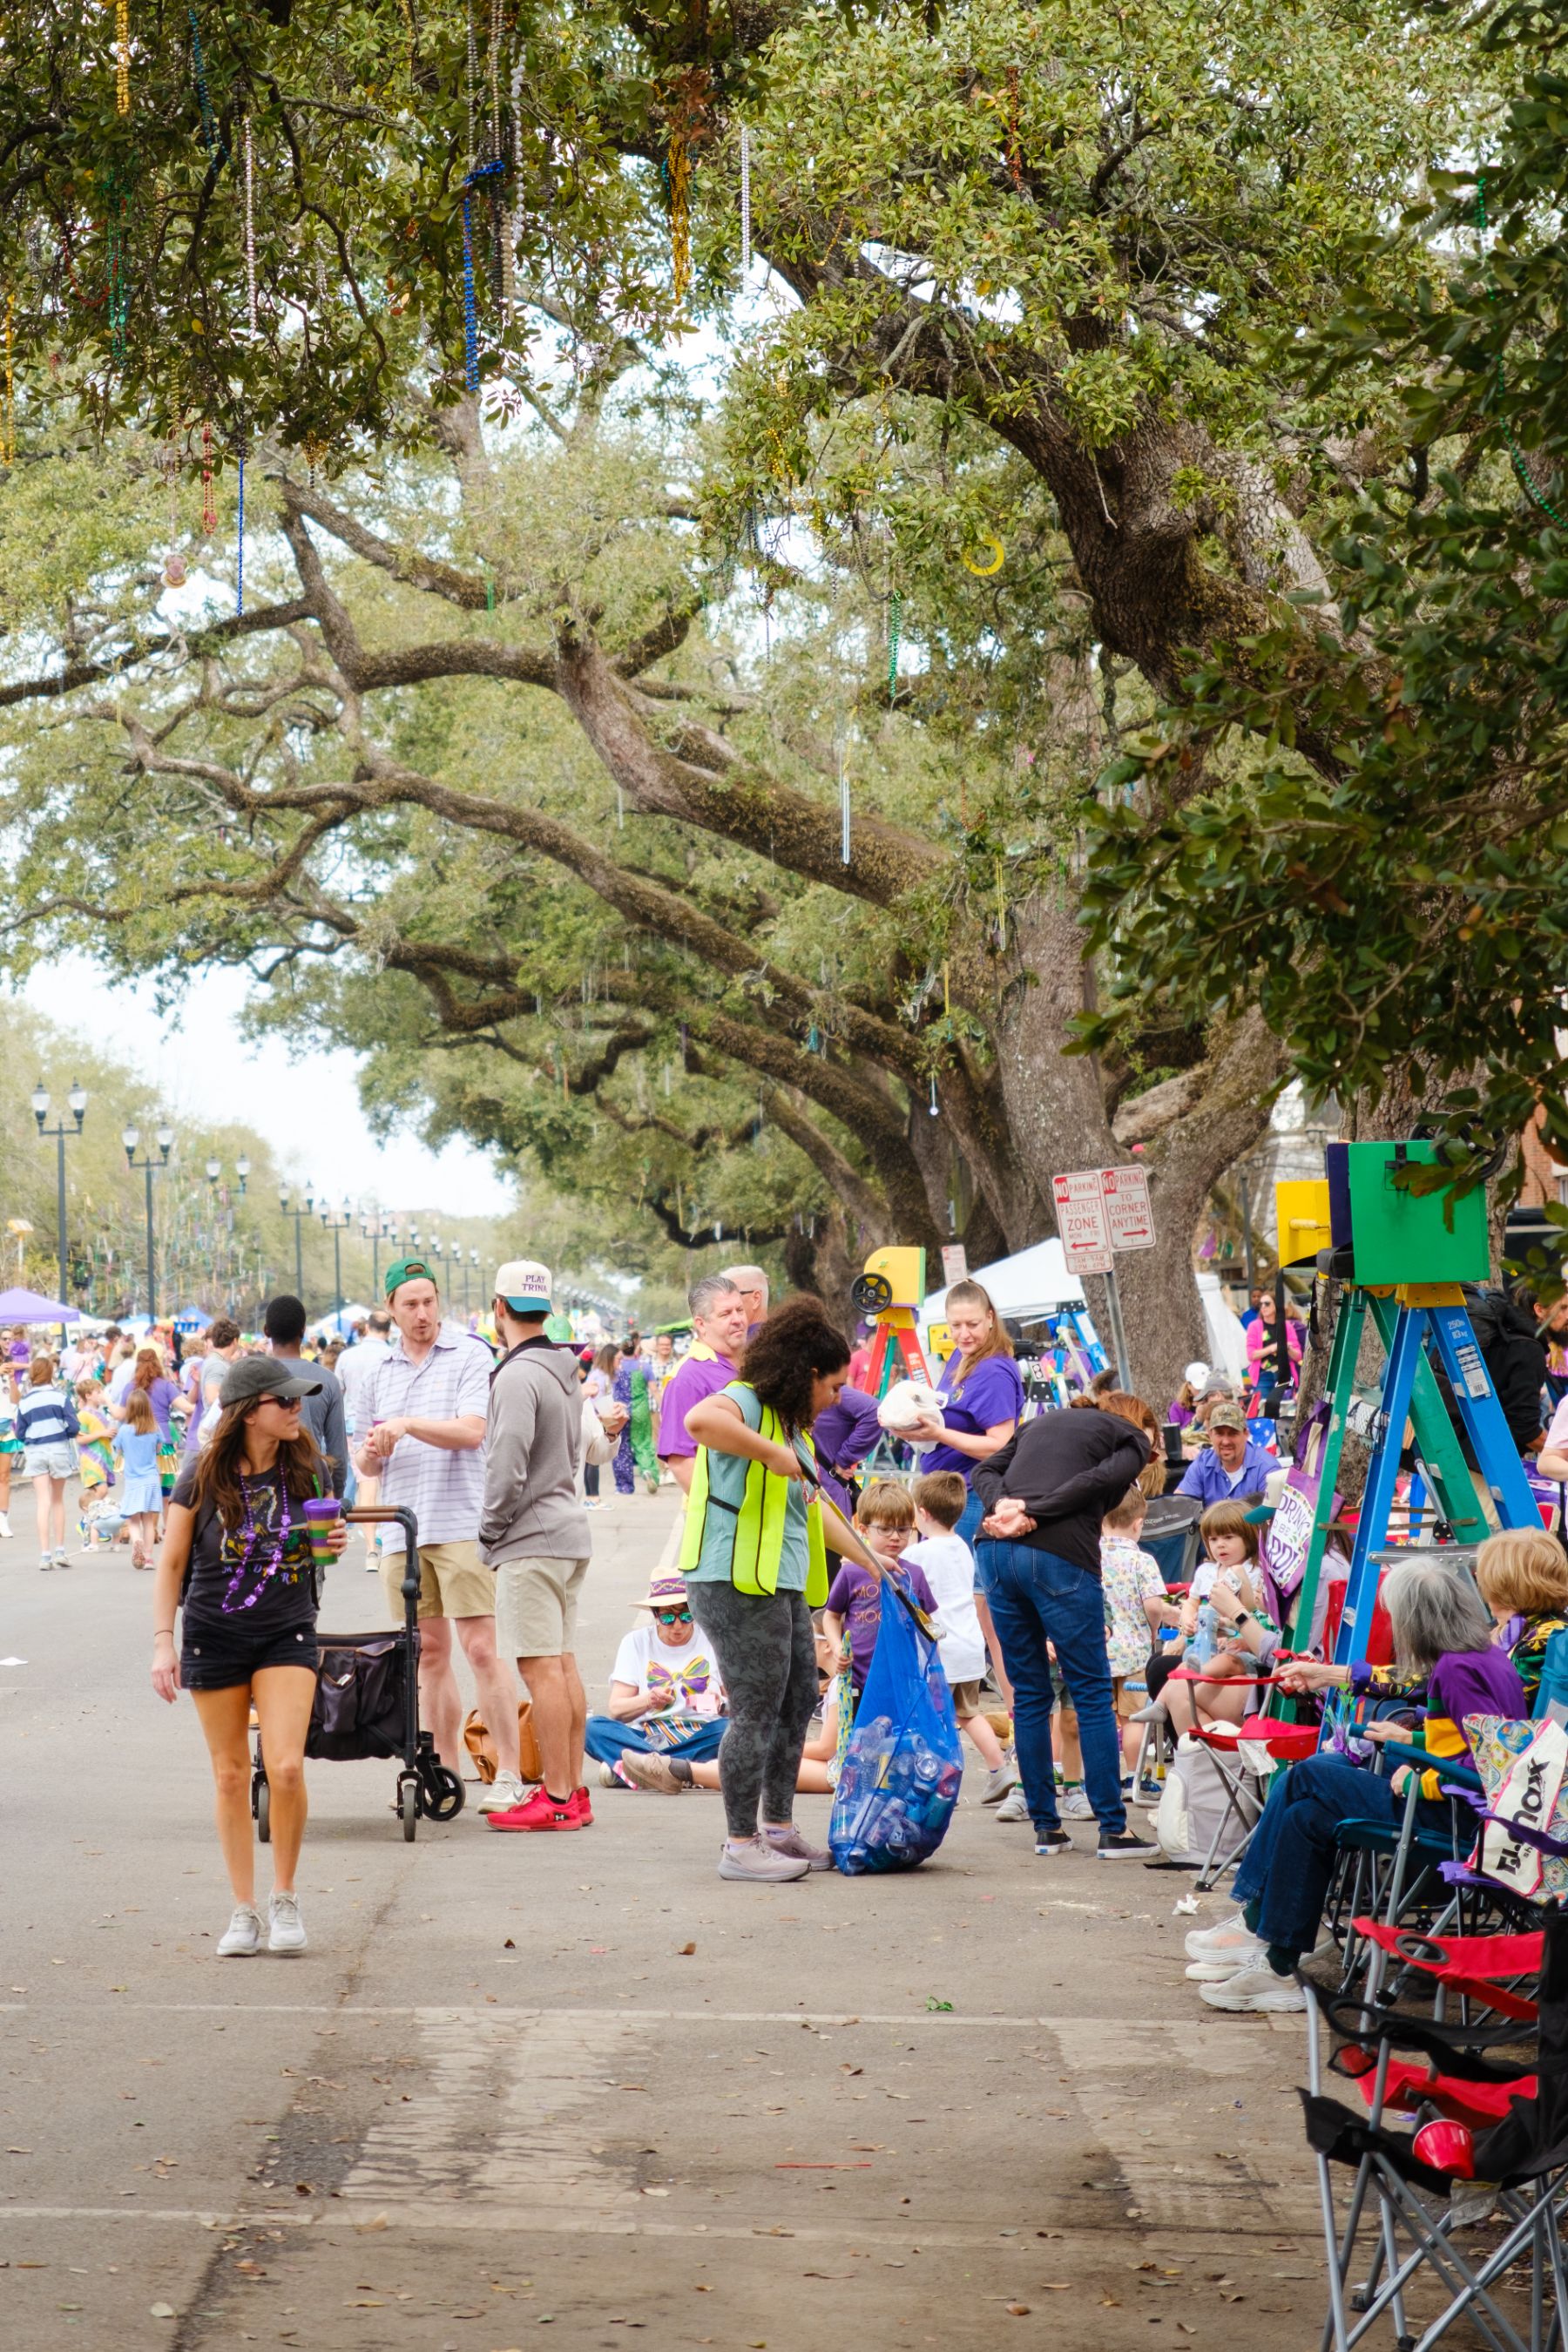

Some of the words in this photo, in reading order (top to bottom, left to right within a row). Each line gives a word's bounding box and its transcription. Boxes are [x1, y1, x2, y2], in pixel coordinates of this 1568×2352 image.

[1104, 1174, 1116, 1192] NO
[1115, 1173, 1144, 1186] PARKING
[1055, 1181, 1069, 1199] NO
[1069, 1181, 1098, 1193] PARKING
[1120, 1193, 1132, 1202] TO
[1059, 1201, 1098, 1215] PASSENGER
[1109, 1202, 1146, 1216] CORNER
[1067, 1216, 1098, 1232] ZONE
[1112, 1214, 1149, 1229] ANYTIME
[525, 1274, 545, 1283] PLAY
